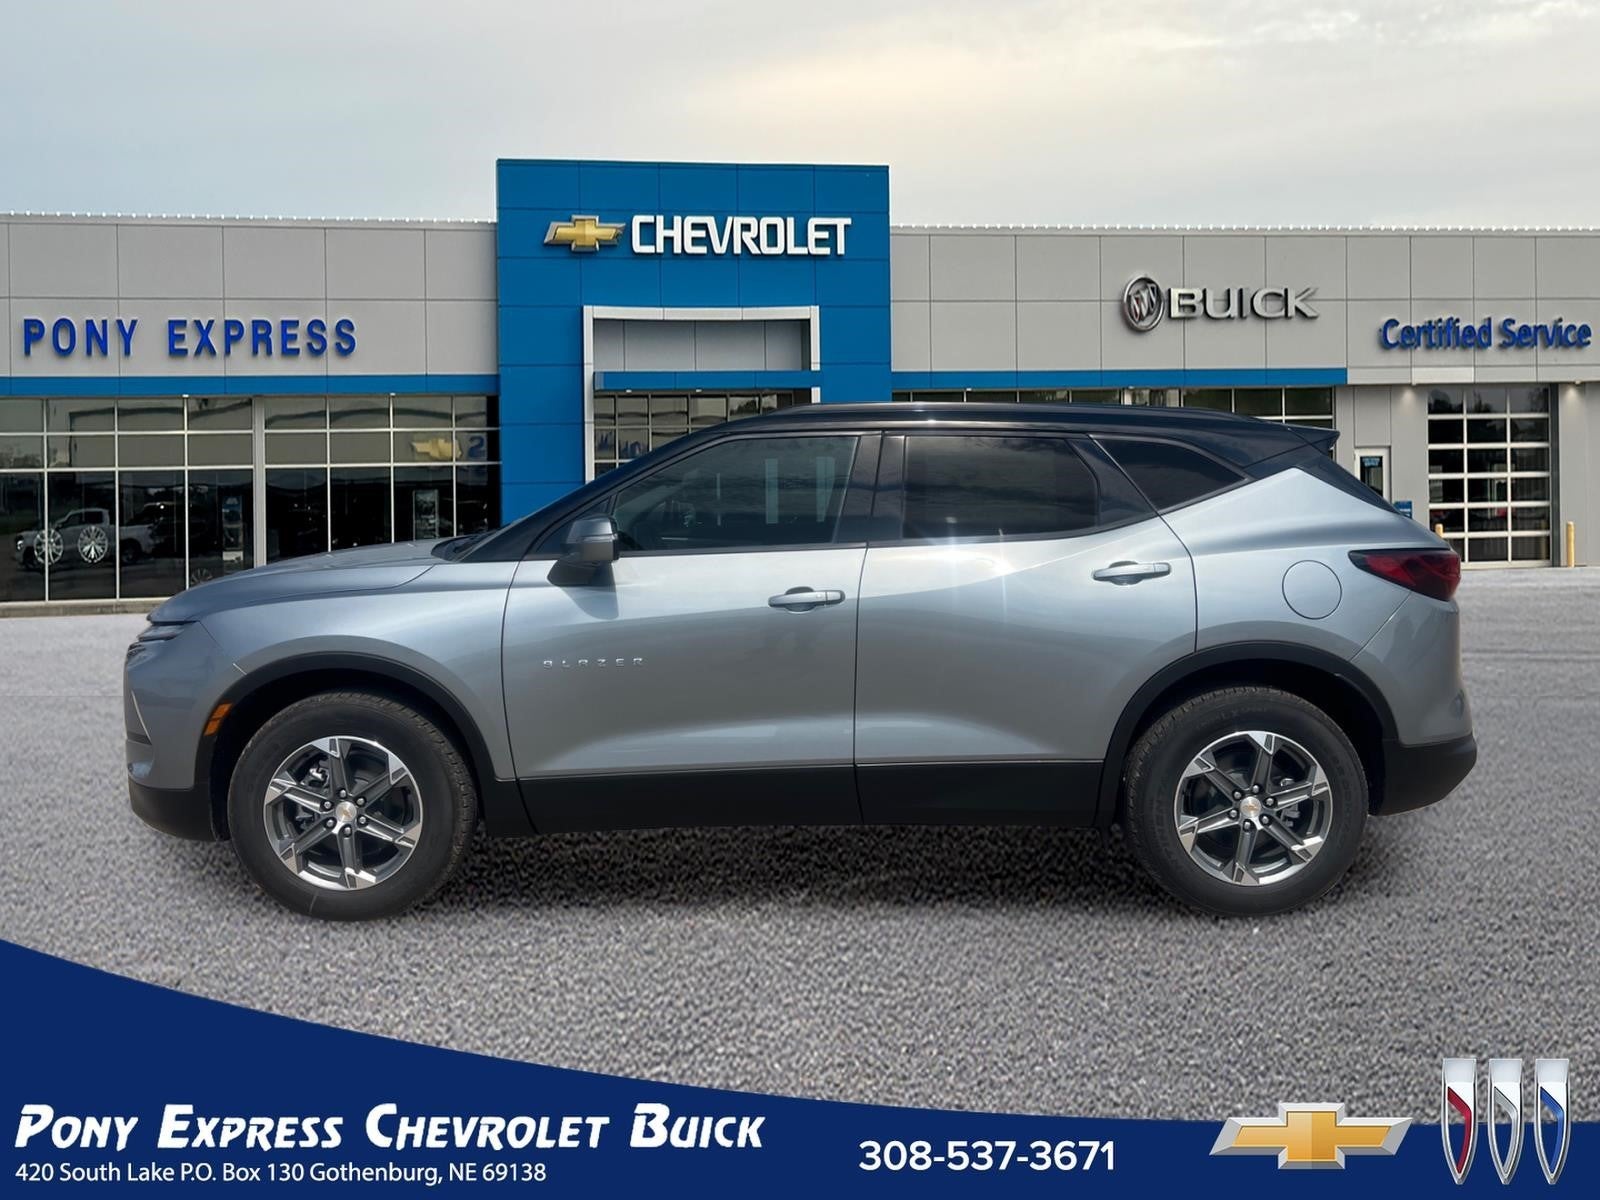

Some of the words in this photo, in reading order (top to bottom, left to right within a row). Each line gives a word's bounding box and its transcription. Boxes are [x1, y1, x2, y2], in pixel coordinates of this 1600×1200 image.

[631, 214, 852, 256] CHEVROLET
[1168, 286, 1320, 320] BUICK
[22, 318, 138, 357] PONY
[167, 318, 358, 357] EXPRESS
[1380, 317, 1493, 350] Certified
[1500, 317, 1592, 348] Service
[542, 656, 644, 669] BLAZER
